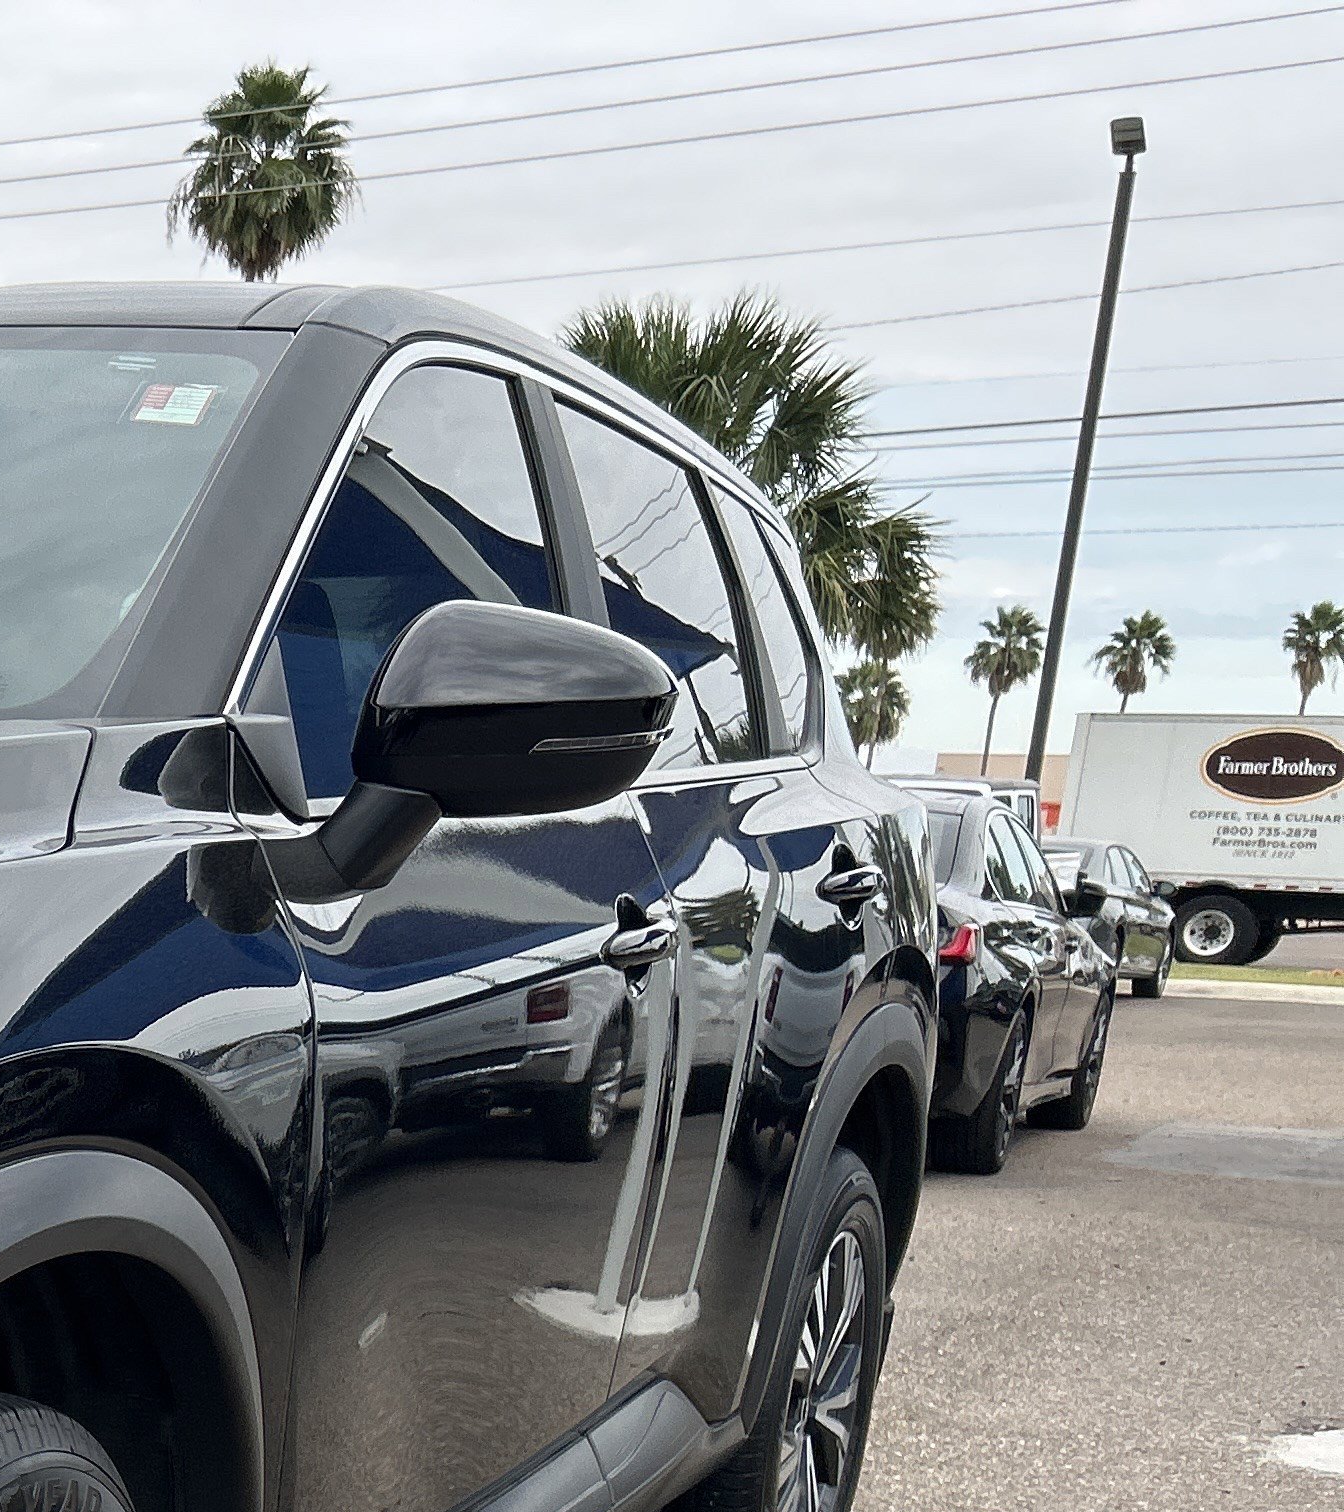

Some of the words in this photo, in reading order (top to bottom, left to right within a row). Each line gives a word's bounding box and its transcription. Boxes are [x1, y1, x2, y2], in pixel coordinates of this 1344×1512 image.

[1217, 755, 1271, 775] Farmer
[1271, 757, 1337, 777] Brothers
[1189, 810, 1241, 822] COFFEE,
[1246, 811, 1269, 822] TEA
[1216, 825, 1253, 838] (800)
[1212, 837, 1318, 850] FarmerBros.com
